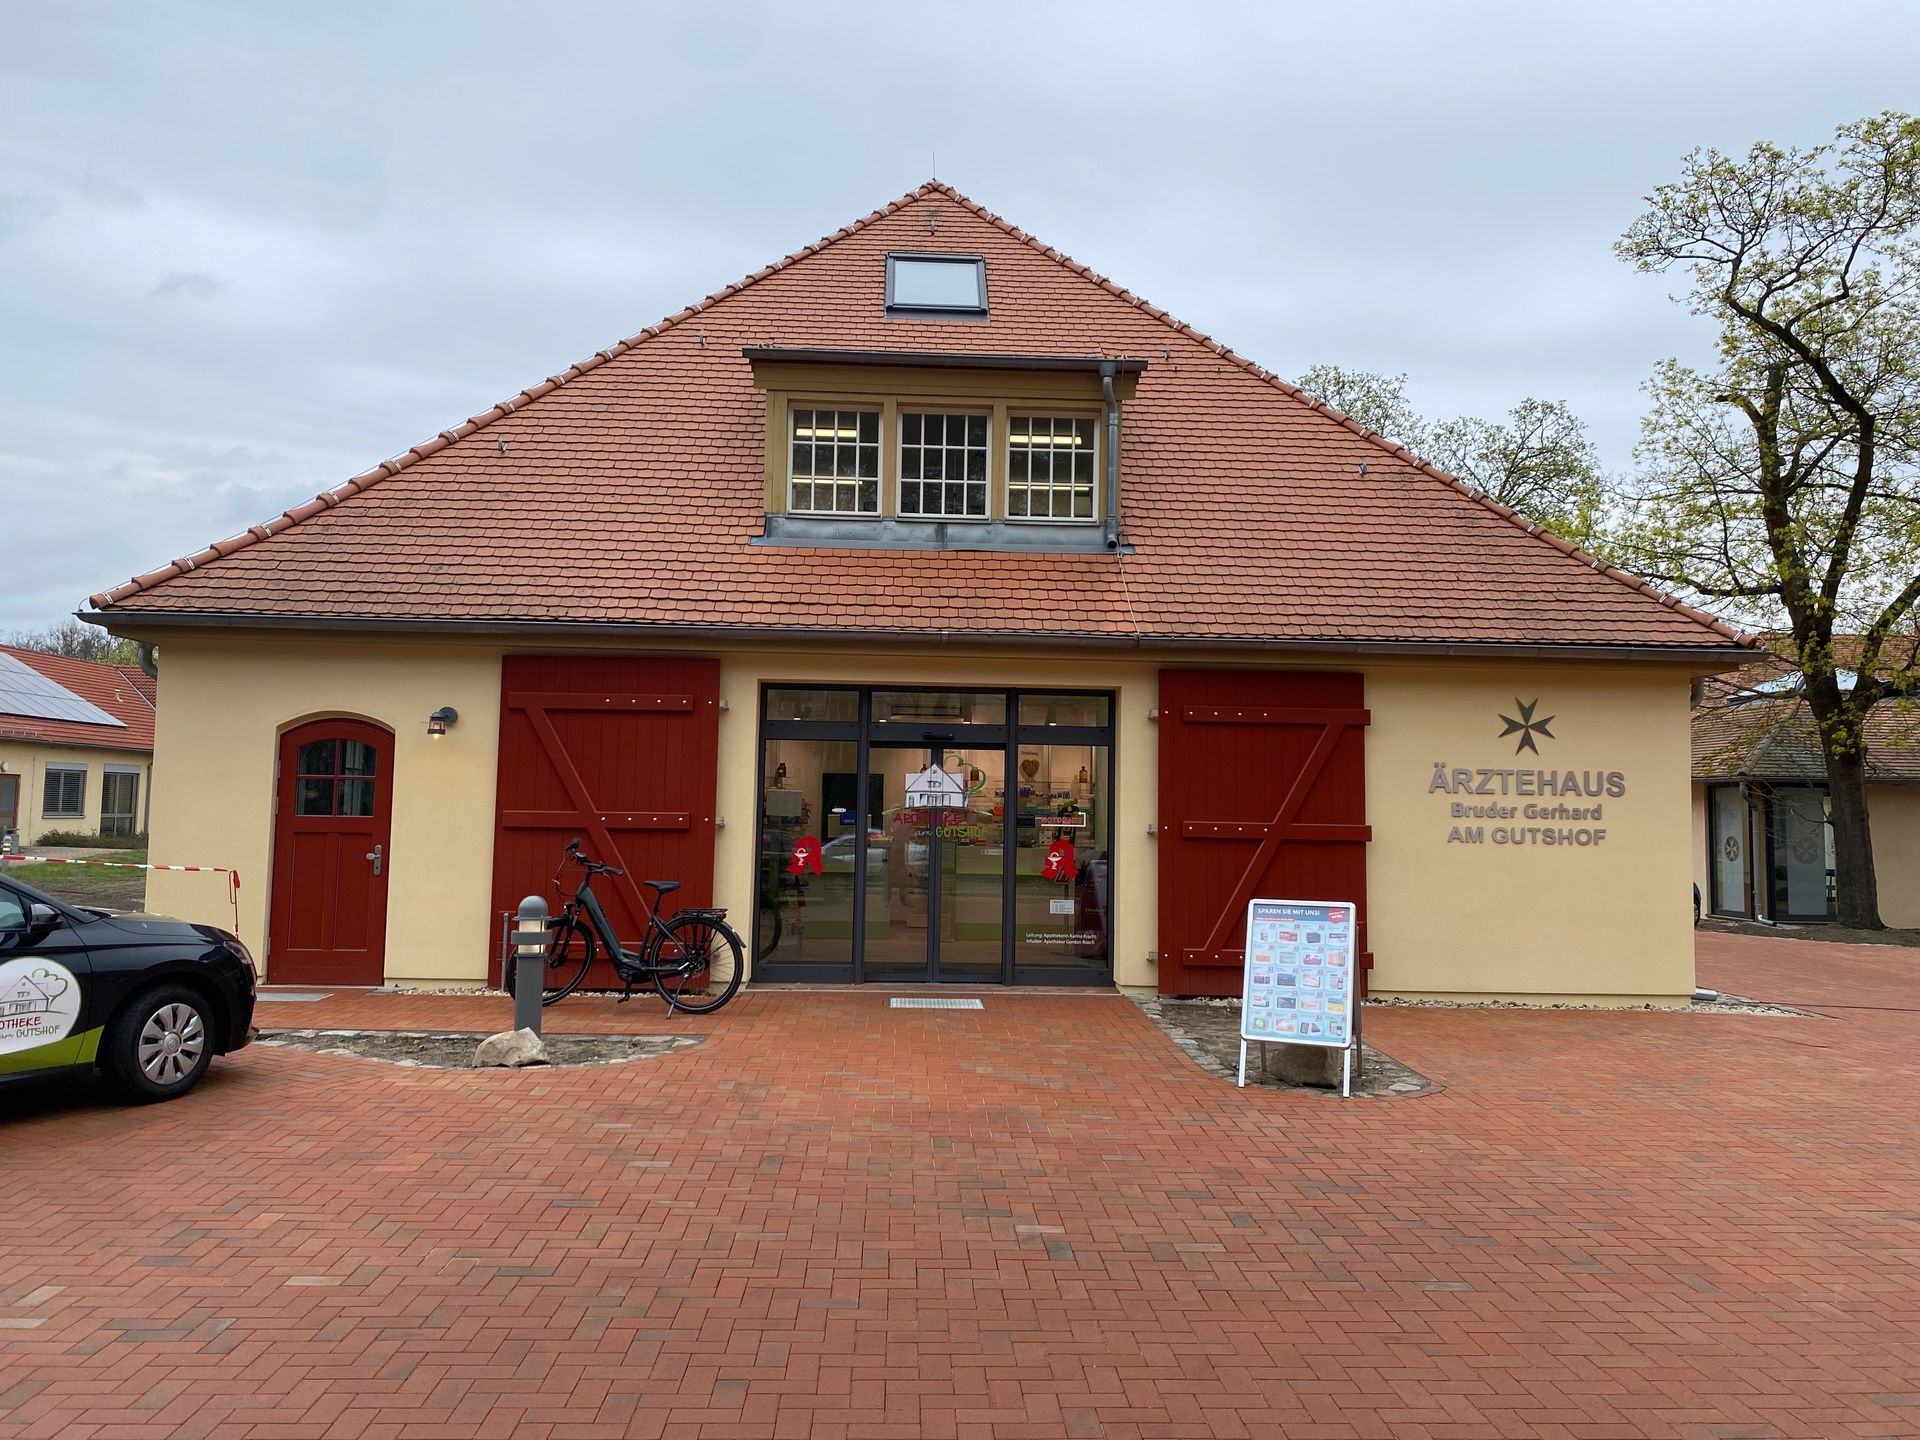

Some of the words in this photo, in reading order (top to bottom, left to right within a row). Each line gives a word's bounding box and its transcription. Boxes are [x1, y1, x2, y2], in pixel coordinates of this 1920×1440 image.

[1428, 762, 1626, 797] ÄRZTEHAUS
[1451, 802, 1517, 819] Bruder
[1523, 803, 1603, 820] Gerhard
[935, 825, 988, 838] GUTSHOF
[1448, 826, 1484, 843] AM
[1491, 827, 1607, 846] GUTSHOF
[16, 1025, 61, 1038] GUTSHOF
